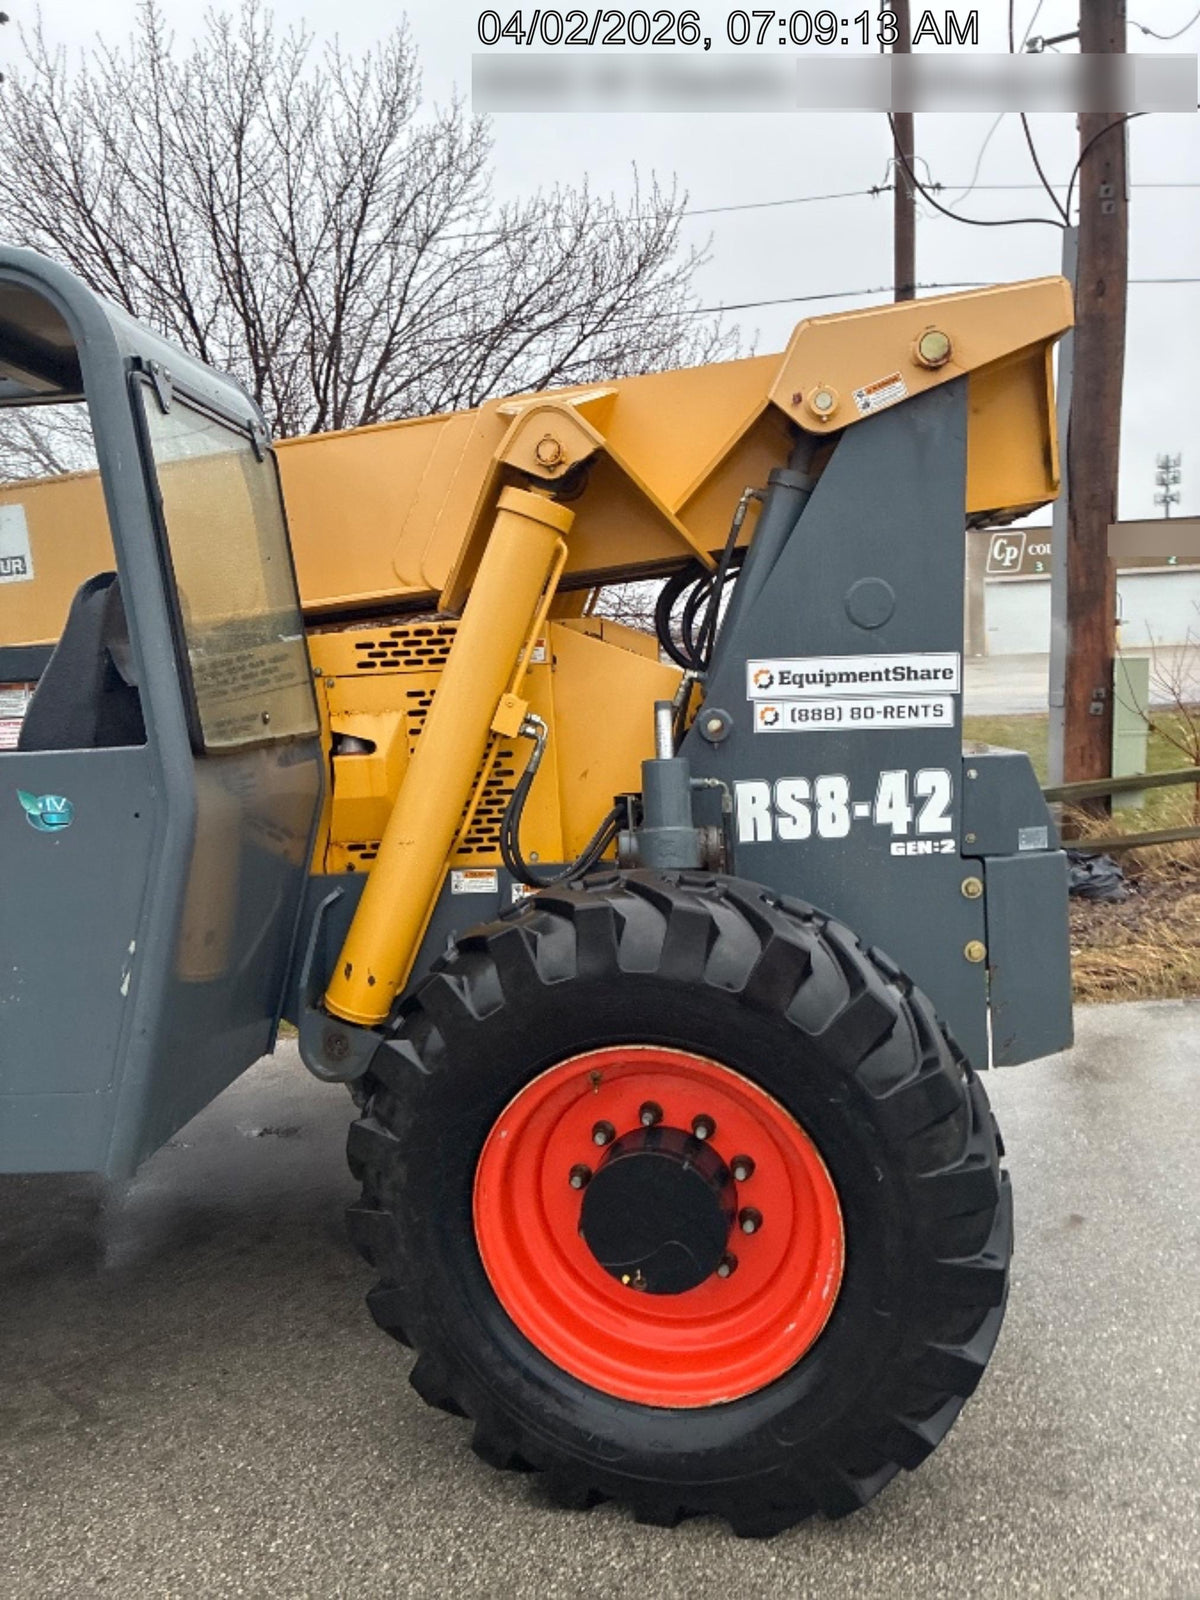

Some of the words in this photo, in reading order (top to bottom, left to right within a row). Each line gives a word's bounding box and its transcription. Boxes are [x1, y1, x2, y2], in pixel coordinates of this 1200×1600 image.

[1035, 561, 1045, 571] 3
[778, 665, 954, 688] EquipmentShare
[790, 707, 842, 722] (888)
[850, 704, 944, 720] 80-RENTS
[734, 768, 953, 843] RS8-42
[890, 839, 956, 856] GEN:2
